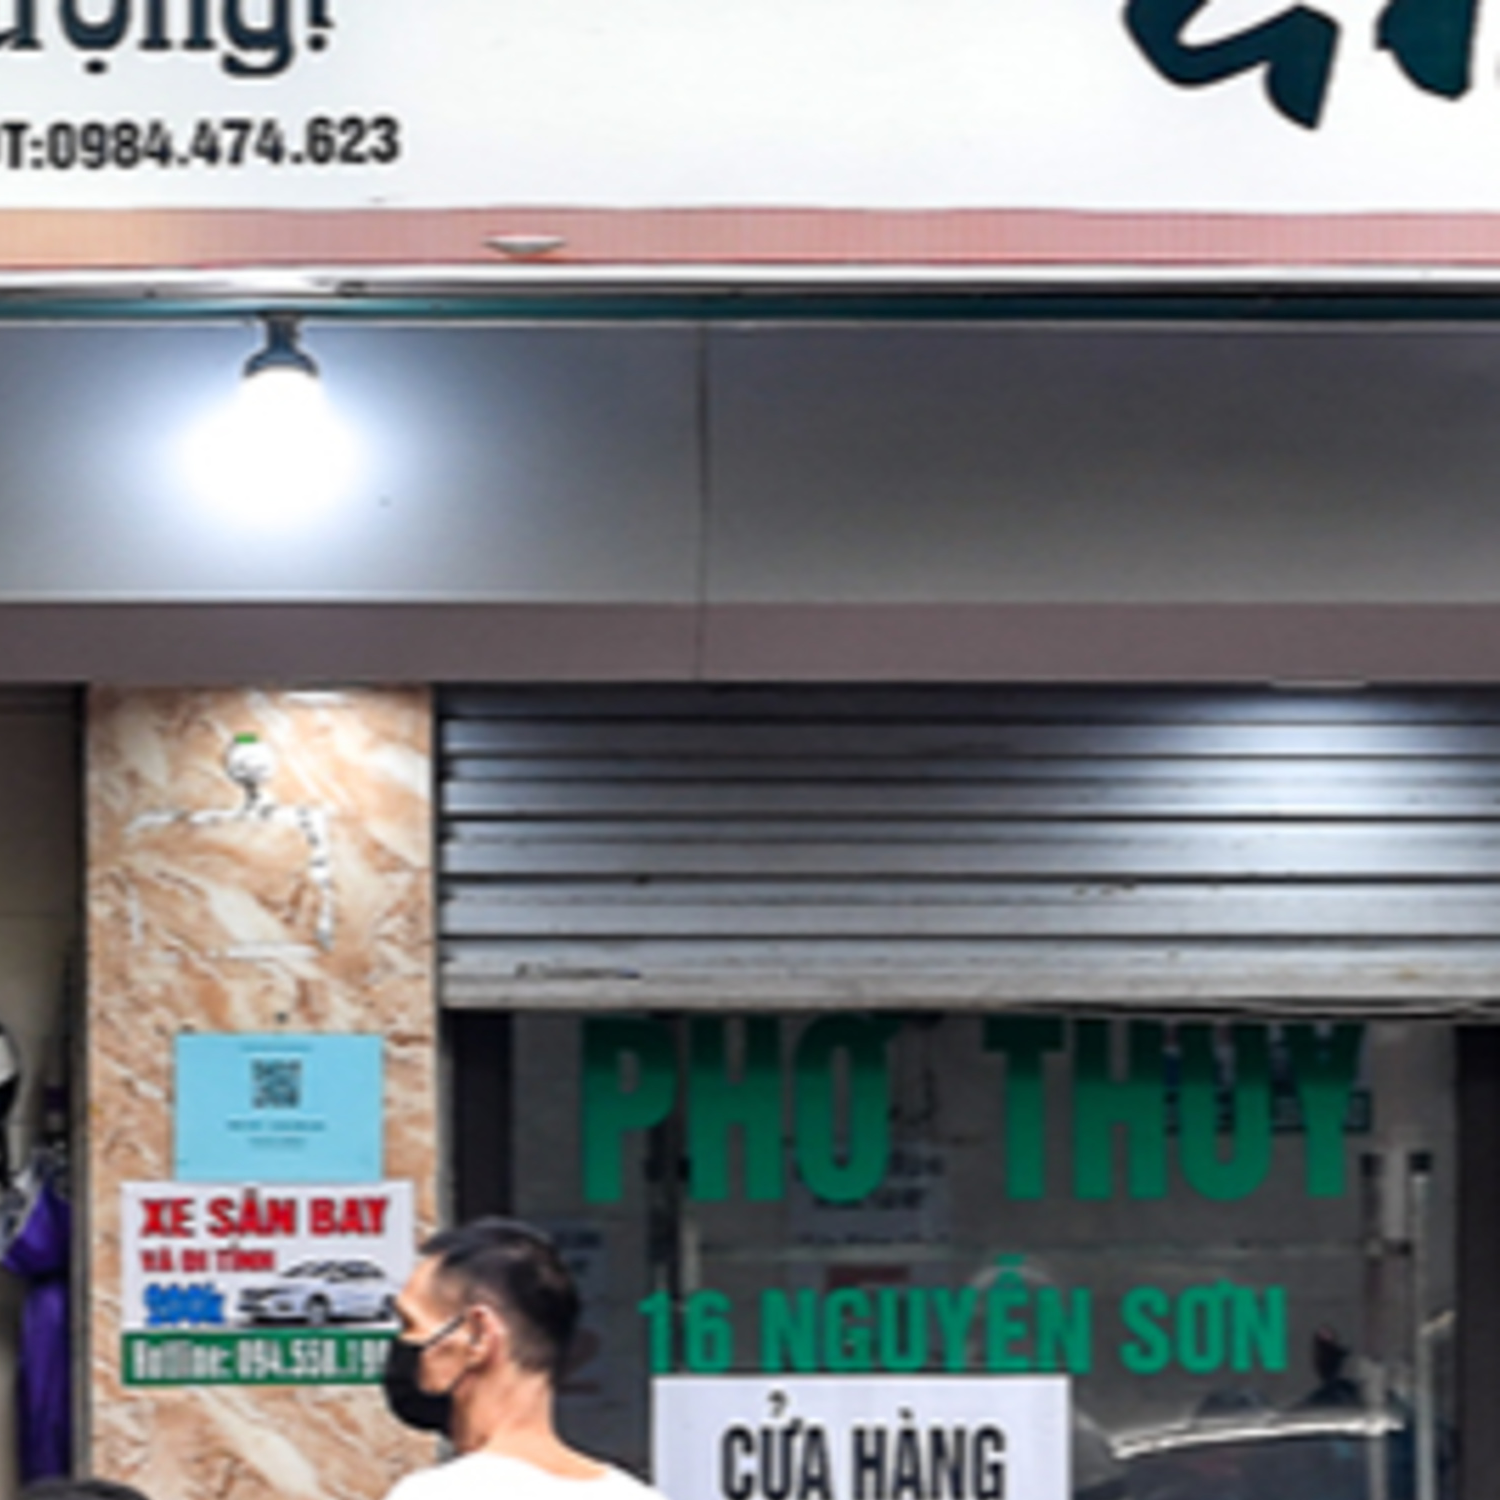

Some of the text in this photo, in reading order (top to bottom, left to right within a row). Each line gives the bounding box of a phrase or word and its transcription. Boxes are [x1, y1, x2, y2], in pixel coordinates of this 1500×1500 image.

[141, 1188, 389, 1238] XE SÂN BAY
[639, 1289, 733, 1374] 16
[1120, 1279, 1289, 1375] SƠN
